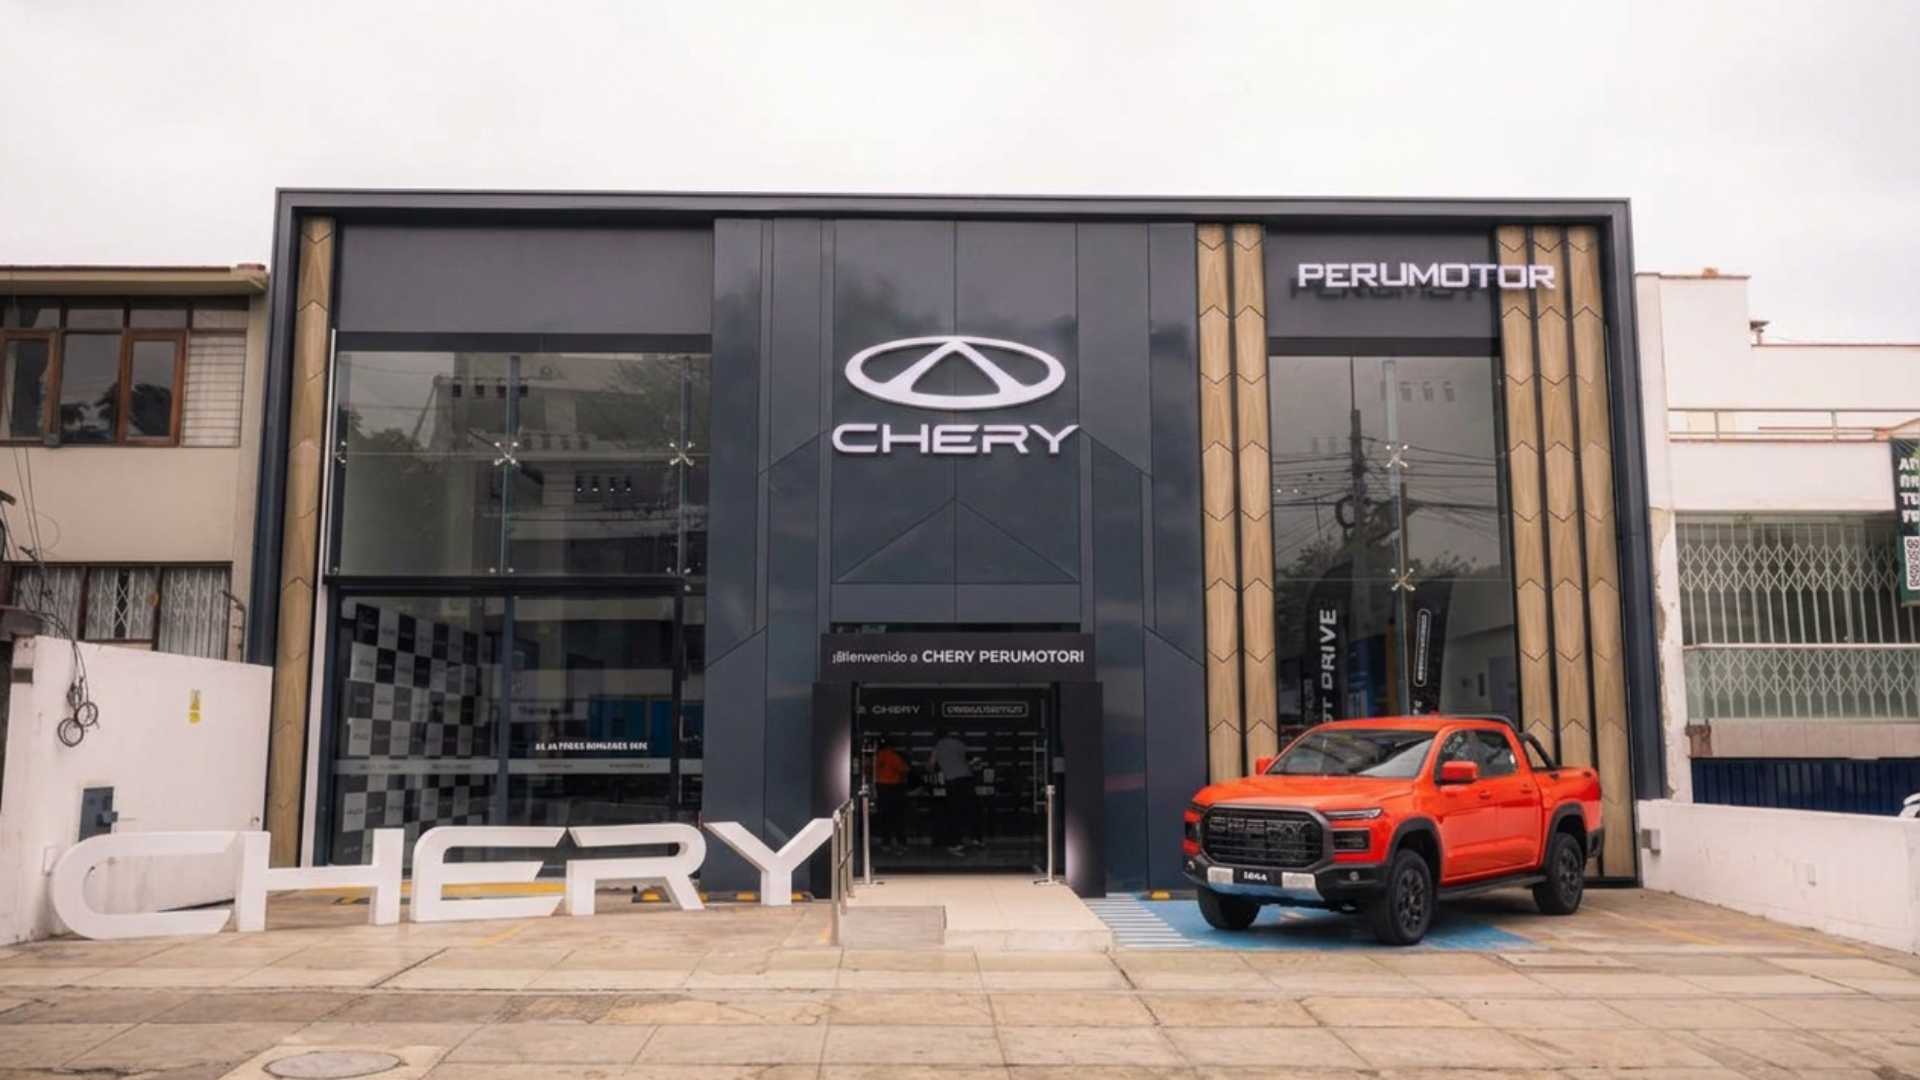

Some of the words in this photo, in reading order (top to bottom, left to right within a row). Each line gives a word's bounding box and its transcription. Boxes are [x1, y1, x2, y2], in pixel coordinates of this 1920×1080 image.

[1298, 262, 1555, 289] PERUMOTOR
[832, 424, 1080, 453] CHERY
[922, 649, 975, 663] CHERY
[1319, 609, 1337, 690] DRIVE
[51, 818, 834, 940] CHERY
